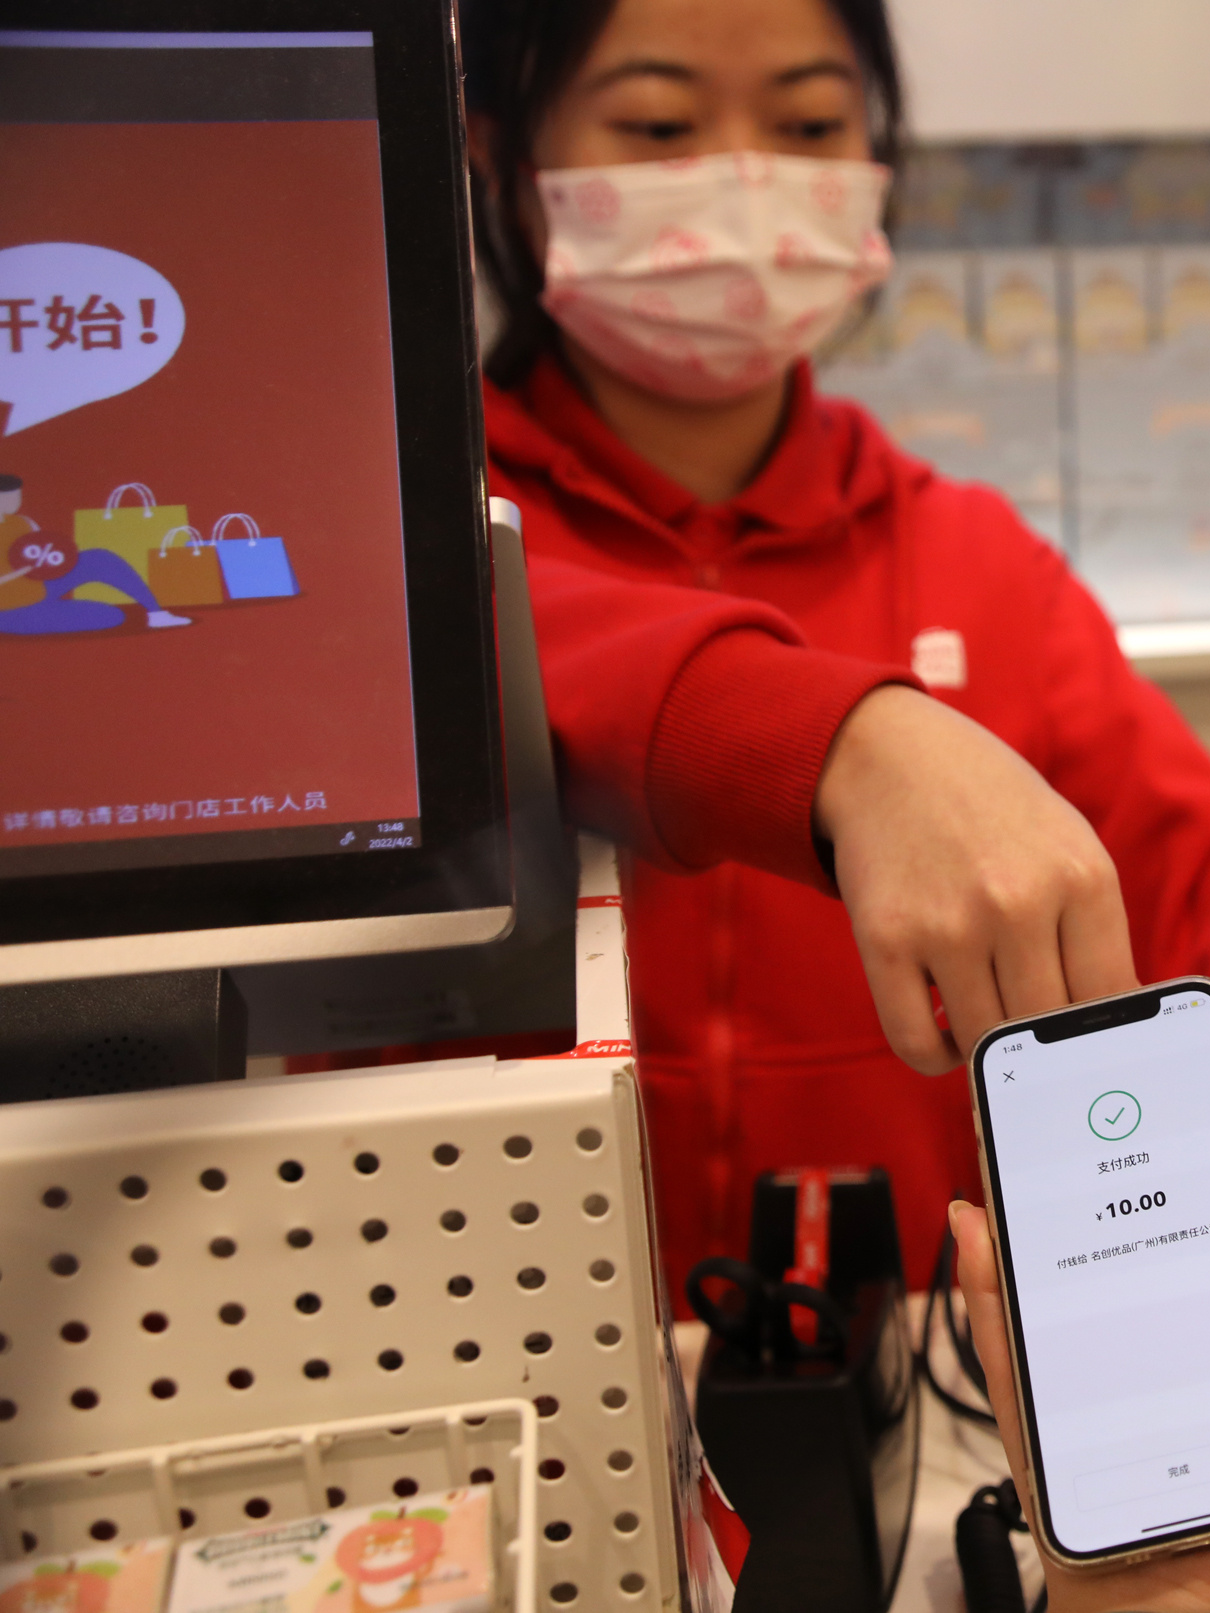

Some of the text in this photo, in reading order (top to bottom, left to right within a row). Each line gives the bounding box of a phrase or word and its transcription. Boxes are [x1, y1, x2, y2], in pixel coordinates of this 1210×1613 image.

[3, 791, 327, 831] 详情敬请咨询门店工作人员
[377, 822, 404, 832] 13:48
[369, 836, 413, 849] 2022/4/2
[1177, 1003, 1188, 1011] 4G
[1003, 1043, 1023, 1054] 1:48
[1097, 1151, 1150, 1175] 支付成功
[1057, 1254, 1088, 1270] 付钱给
[1167, 1464, 1190, 1479] 完成
